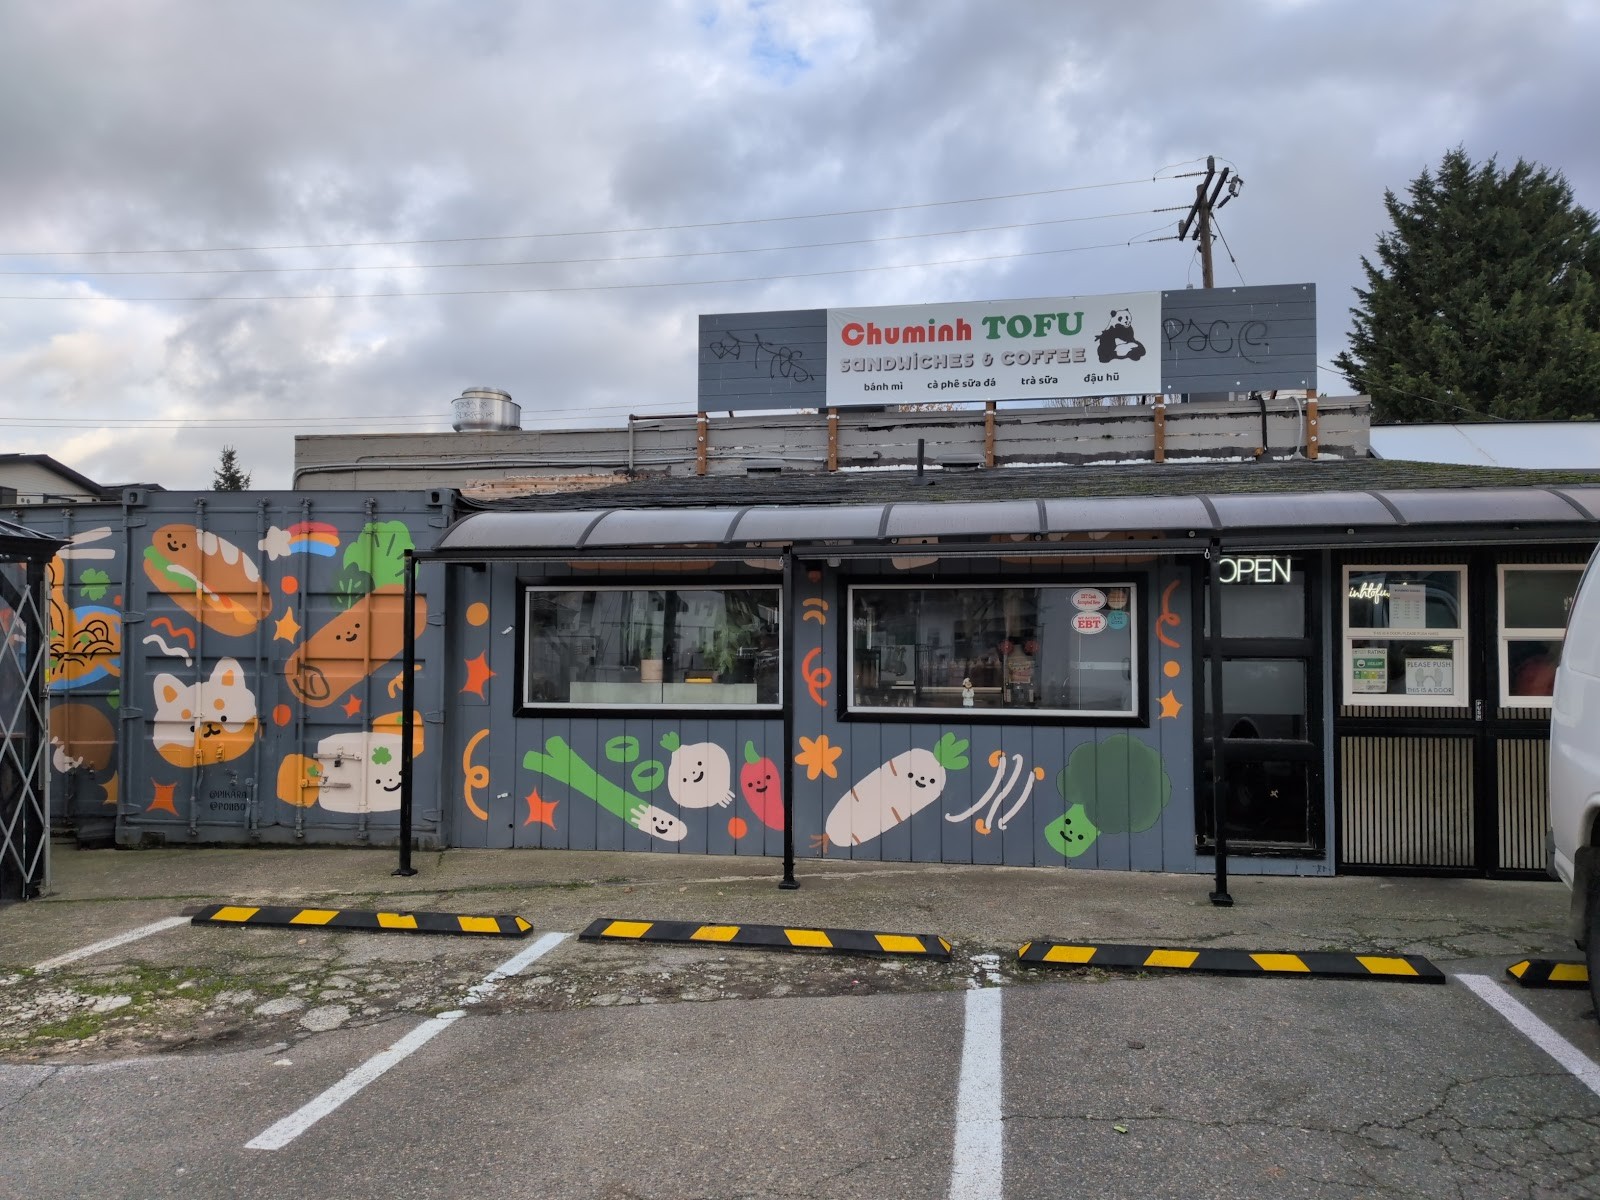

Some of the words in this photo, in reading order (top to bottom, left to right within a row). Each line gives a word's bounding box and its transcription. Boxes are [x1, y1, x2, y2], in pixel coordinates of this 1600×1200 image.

[841, 318, 972, 346] Chuminh
[981, 311, 1085, 340] TOFU
[982, 352, 994, 367] &
[1001, 348, 1087, 366] COFFEE
[864, 382, 889, 391] bánh
[927, 380, 939, 389] cà
[941, 379, 960, 390] phê
[983, 377, 996, 387] đá
[1021, 376, 1036, 385] trà
[1084, 373, 1103, 385] đậu
[1219, 558, 1291, 582] OPEN
[1077, 620, 1101, 629] EBT
